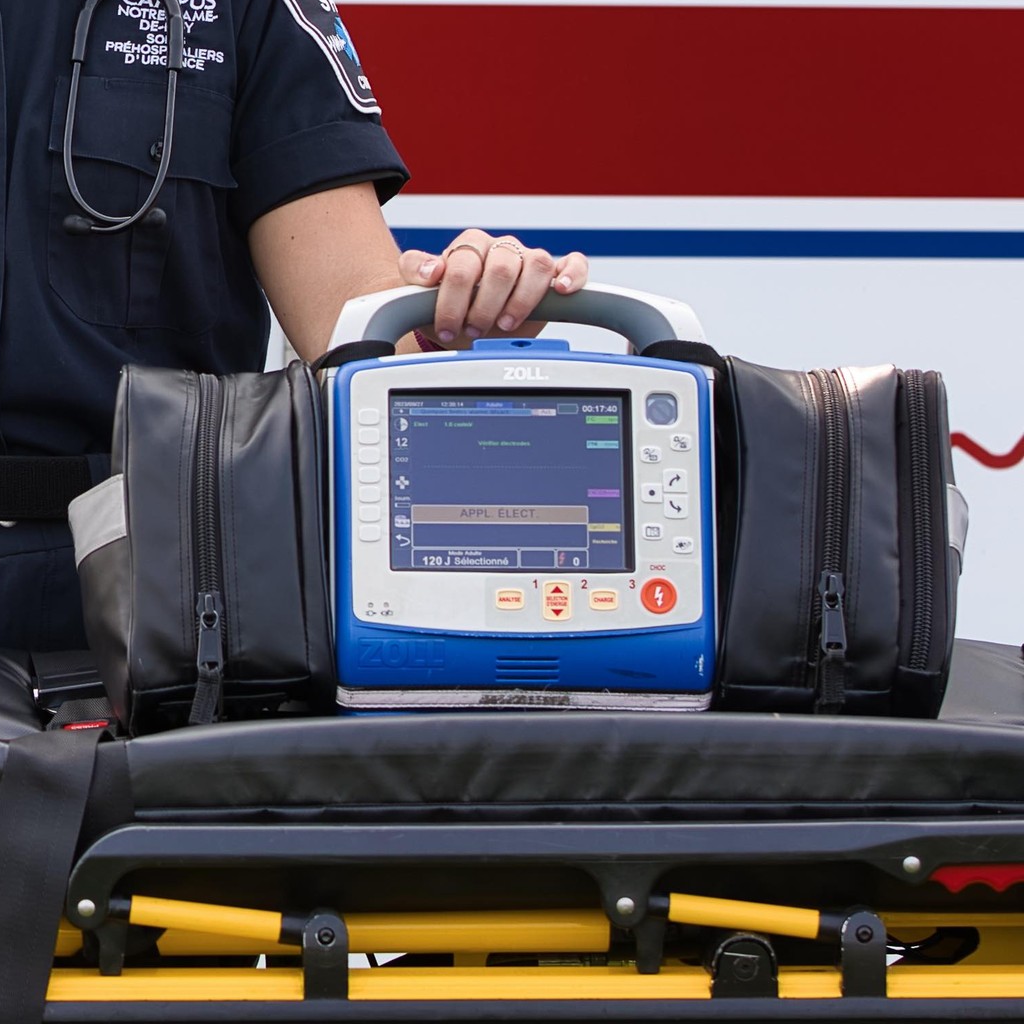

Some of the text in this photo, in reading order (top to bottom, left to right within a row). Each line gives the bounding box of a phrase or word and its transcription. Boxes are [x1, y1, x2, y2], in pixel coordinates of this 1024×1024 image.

[124, 53, 206, 71] D'URGNCE
[582, 405, 618, 413] 00:17:40
[395, 437, 409, 448] 12
[460, 508, 494, 519] APPL.
[422, 556, 509, 567] 120 J Sélectionné
[572, 556, 580, 567] 0
[532, 579, 538, 589] 1
[581, 579, 588, 589] 2
[629, 579, 636, 589] 3
[358, 638, 446, 670] ZOLL
